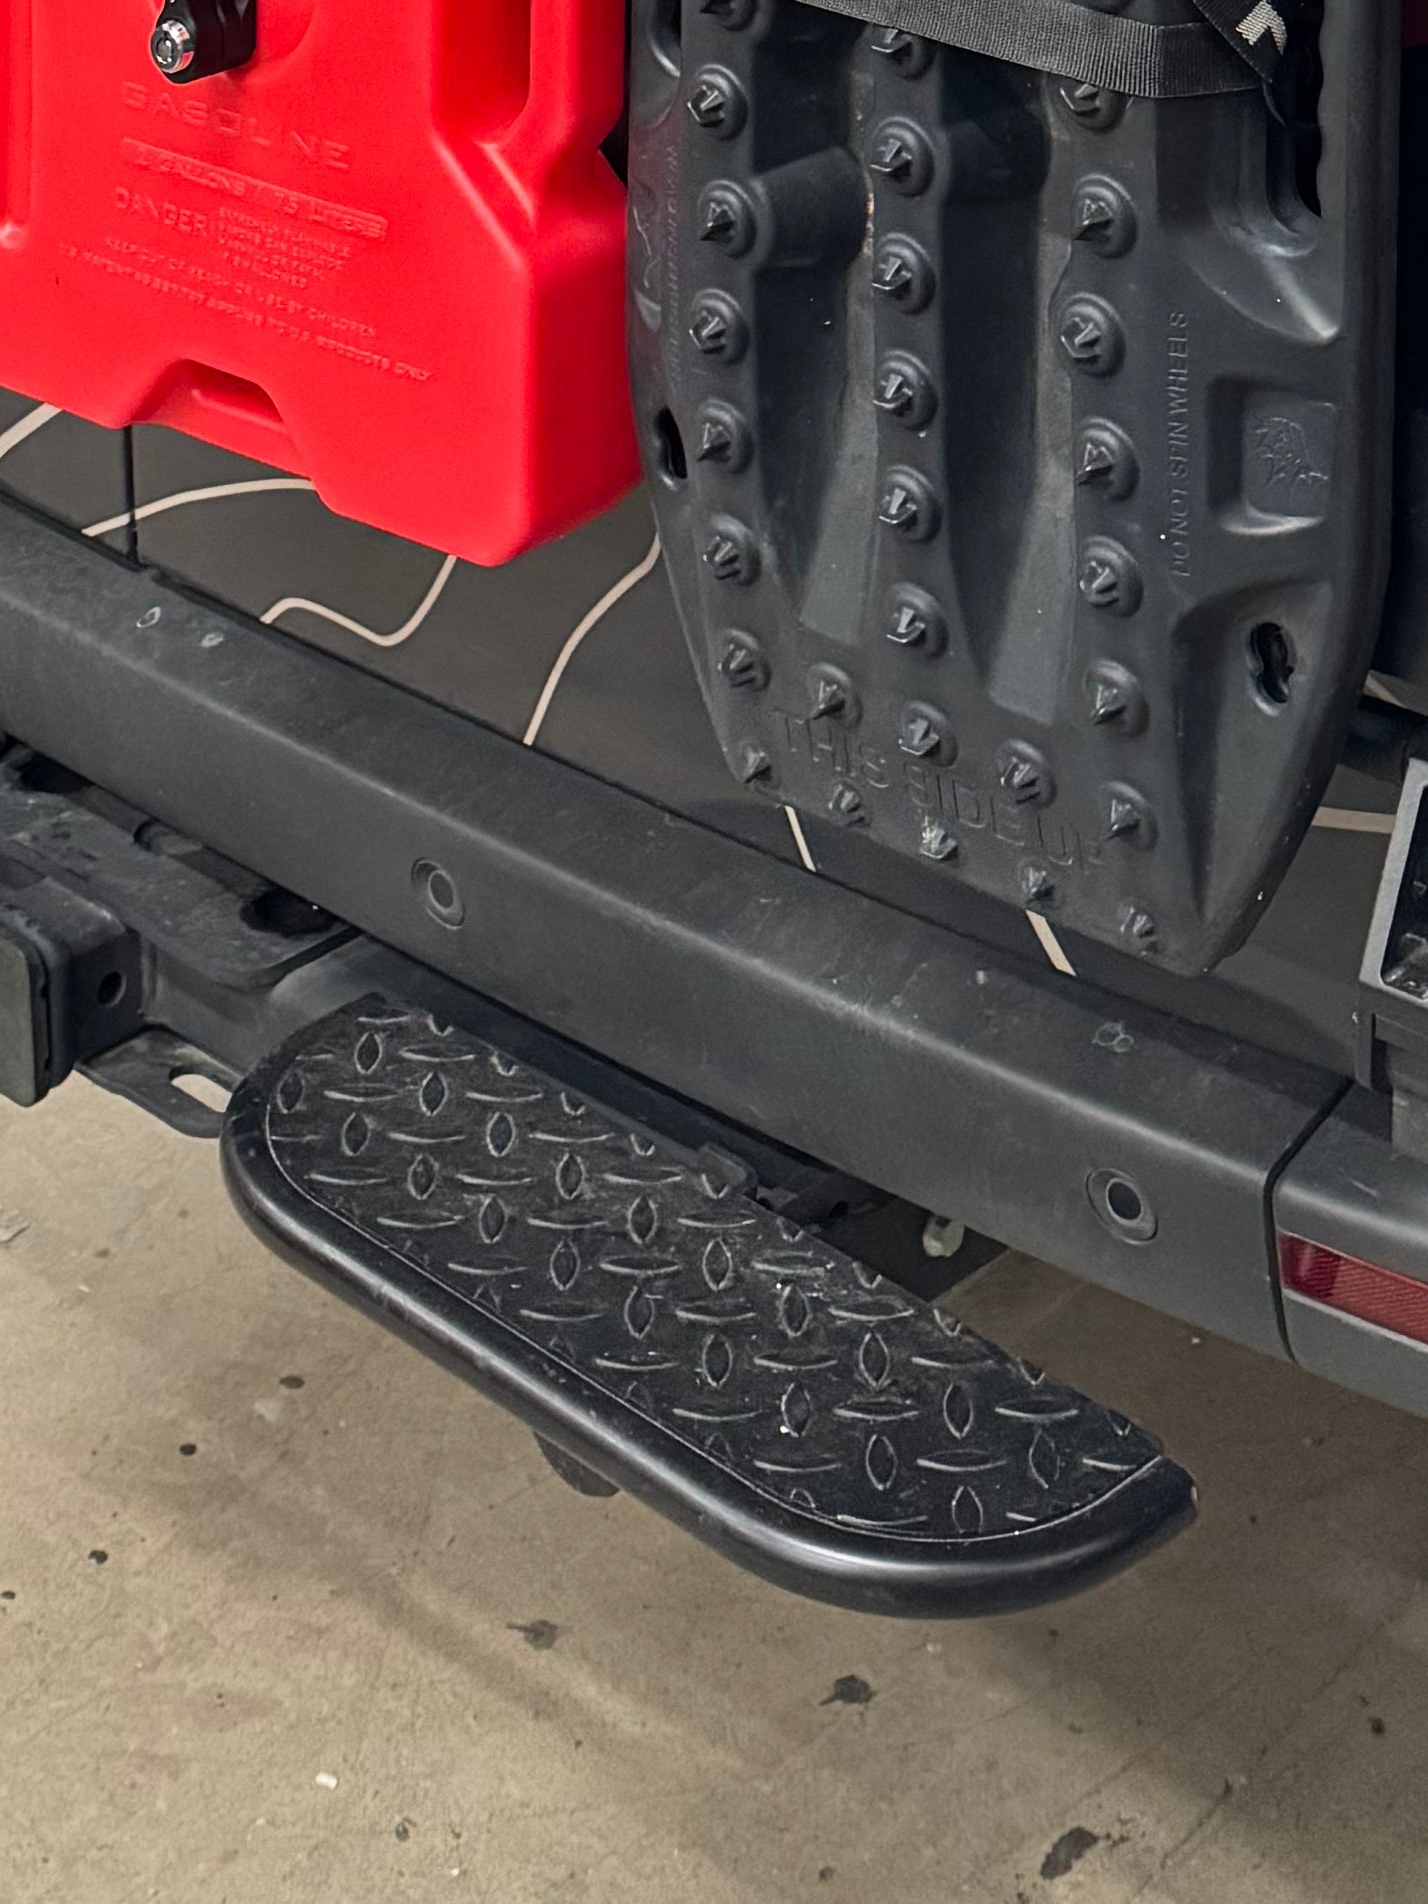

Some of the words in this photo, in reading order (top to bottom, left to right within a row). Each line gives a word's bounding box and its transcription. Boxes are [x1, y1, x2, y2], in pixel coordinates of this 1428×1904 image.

[1167, 310, 1189, 414] WHEELS
[1168, 421, 1189, 478] SPIN
[1170, 488, 1190, 535] NOT
[1170, 540, 1190, 576] DO
